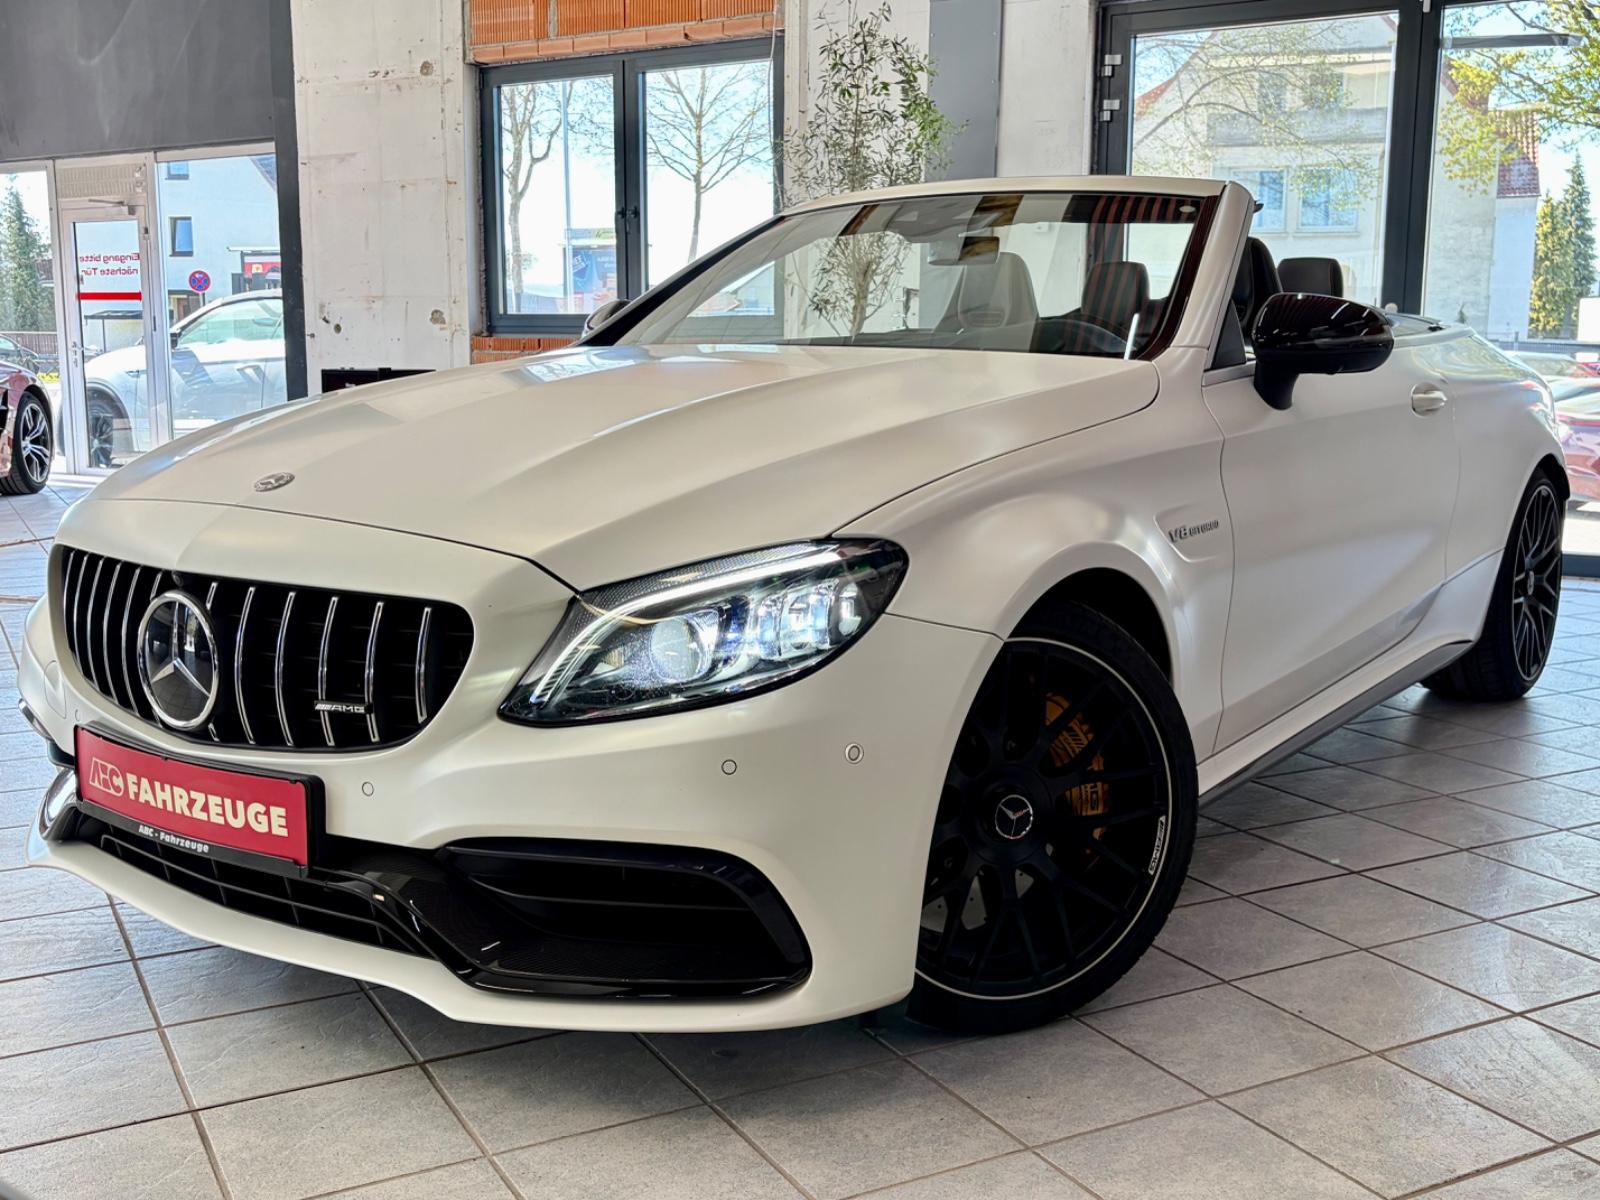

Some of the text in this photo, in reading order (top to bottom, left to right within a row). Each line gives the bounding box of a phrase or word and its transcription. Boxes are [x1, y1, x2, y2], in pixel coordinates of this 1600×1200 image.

[1168, 525, 1187, 543] V8
[331, 704, 365, 713] AMG
[126, 772, 289, 838] FAHRZEUGE
[138, 825, 154, 837] ABC
[159, 832, 209, 853] Fahrzeuge
